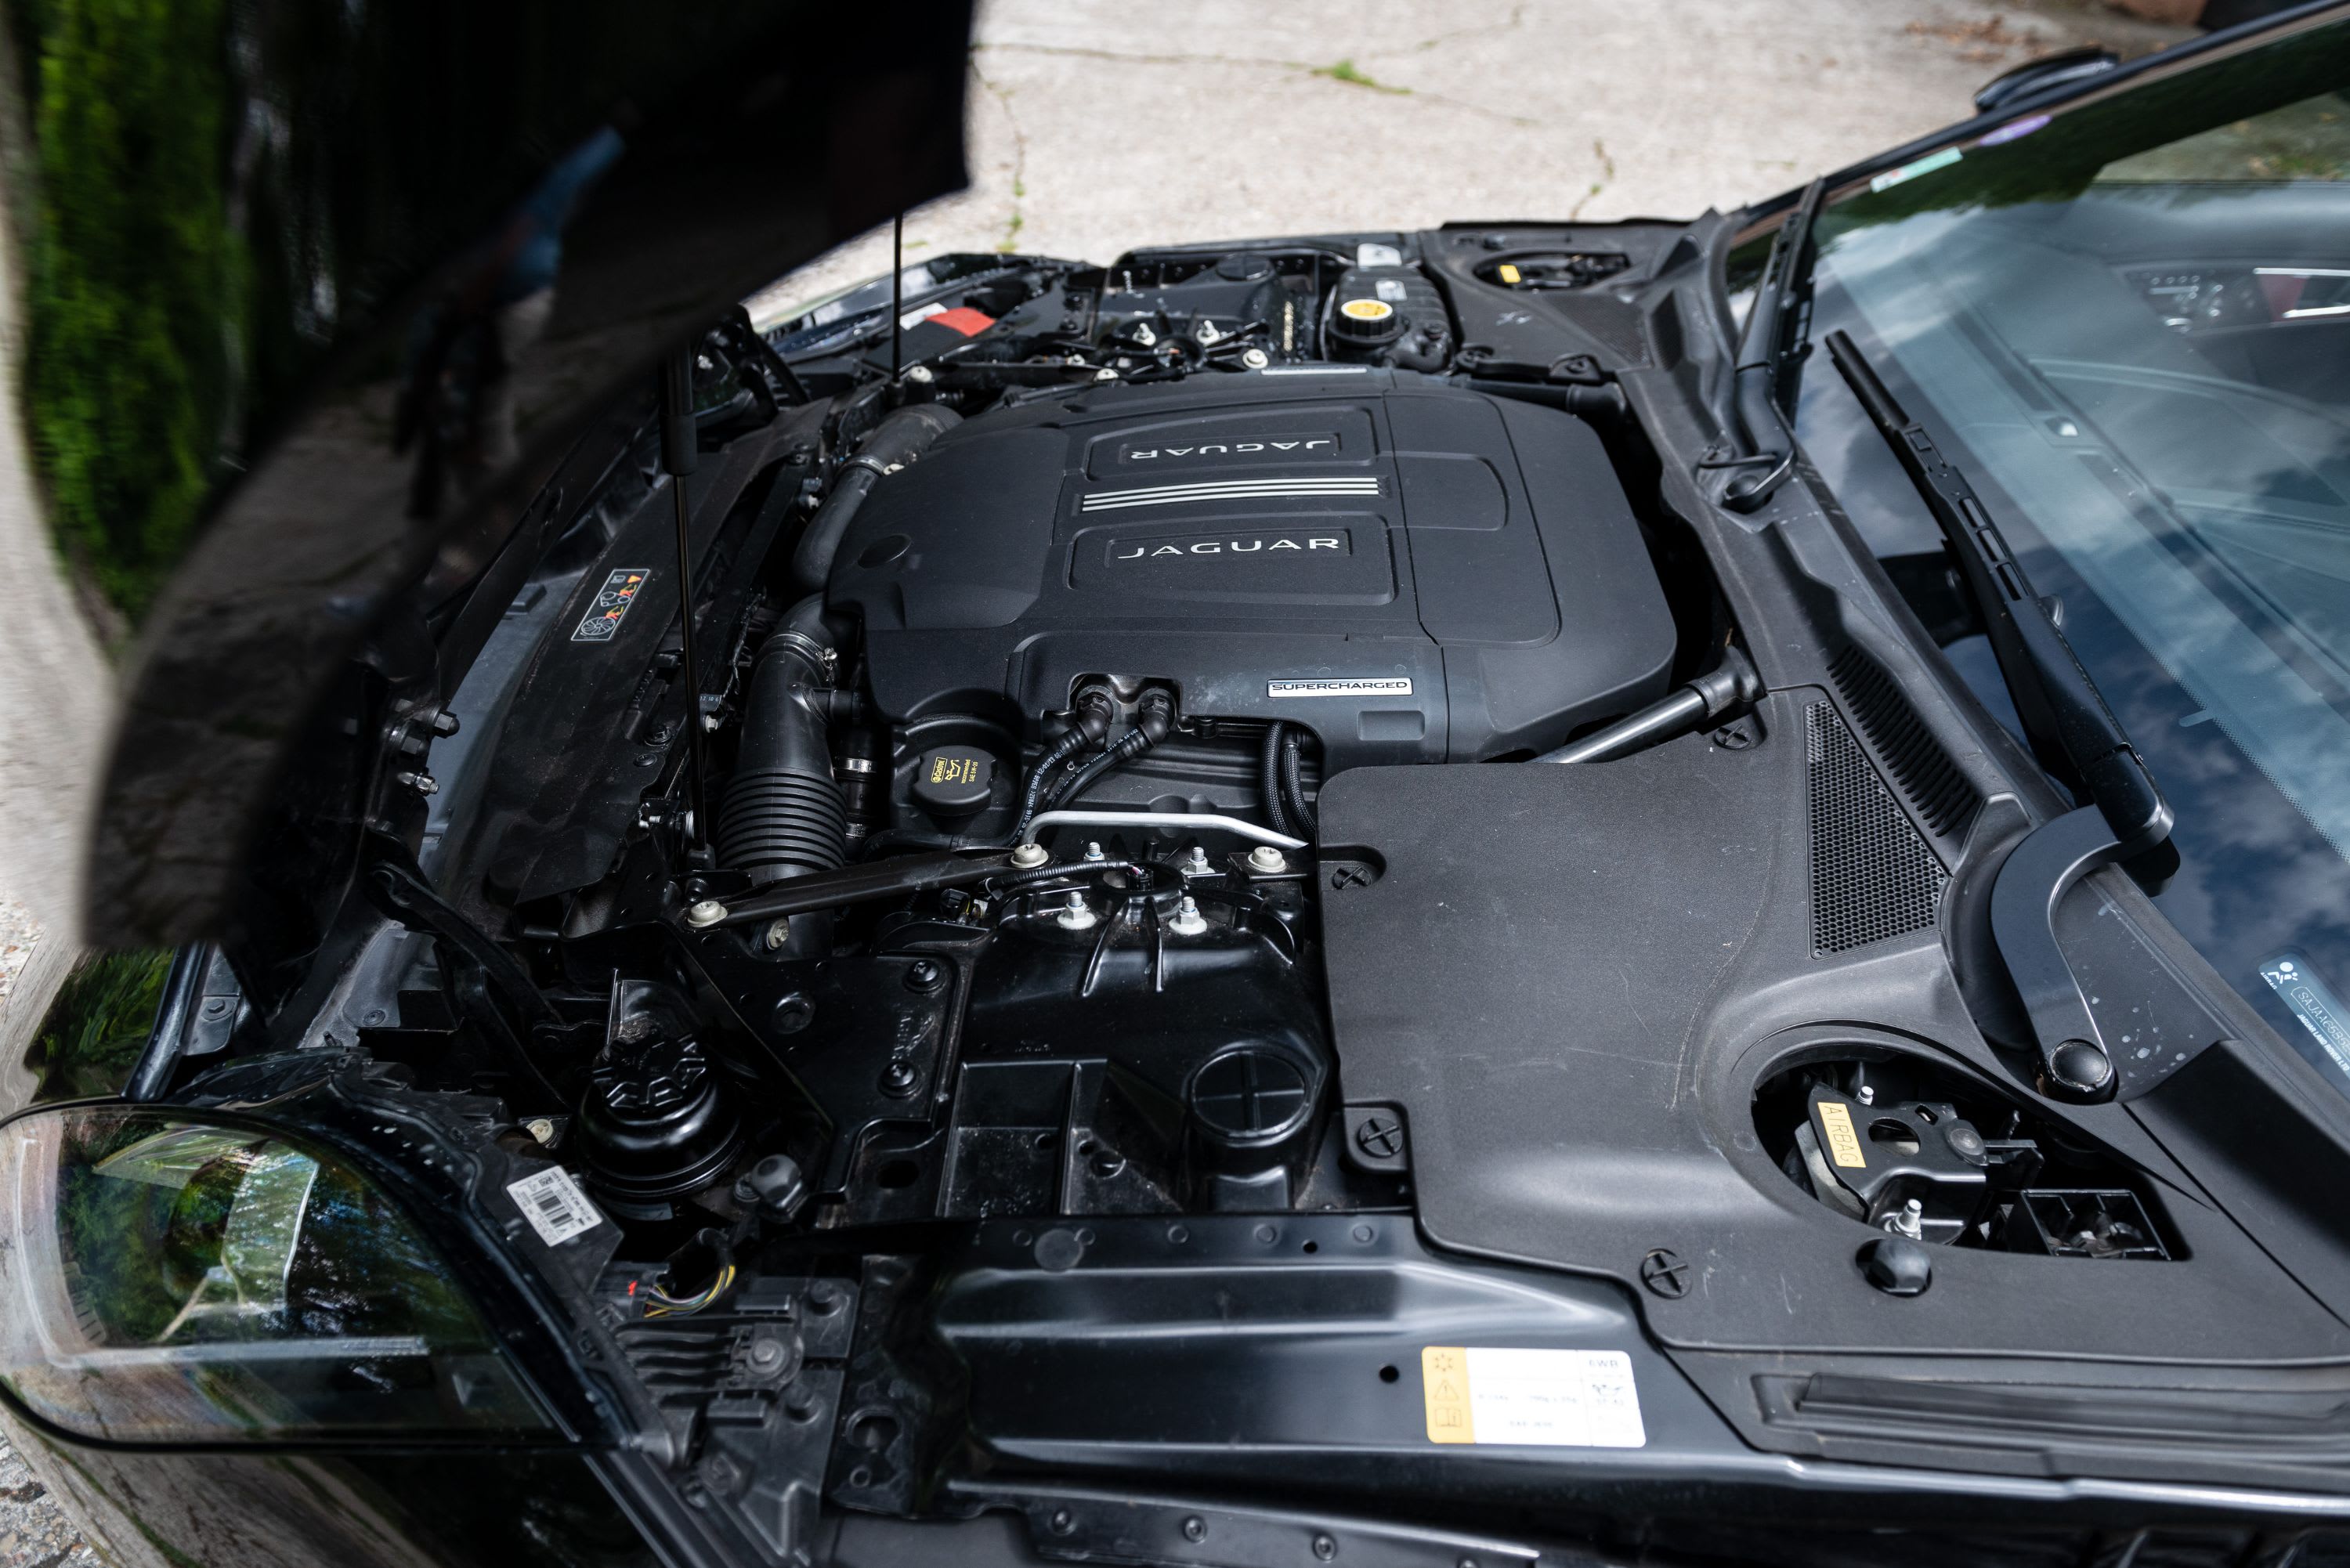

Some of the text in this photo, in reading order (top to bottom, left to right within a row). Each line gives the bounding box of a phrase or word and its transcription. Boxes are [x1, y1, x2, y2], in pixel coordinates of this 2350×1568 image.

[1130, 439, 1331, 460] JAGUAR
[1117, 537, 1340, 559] JAGUAR
[1271, 681, 1408, 692] SUPERCHARGED
[934, 760, 945, 778] Castrol
[2296, 1013, 2316, 1033] JAGUAR
[2312, 1030, 2328, 1046] LAND
[2323, 1043, 2342, 1063] ROVER
[1824, 1106, 1858, 1162] AIRBAG
